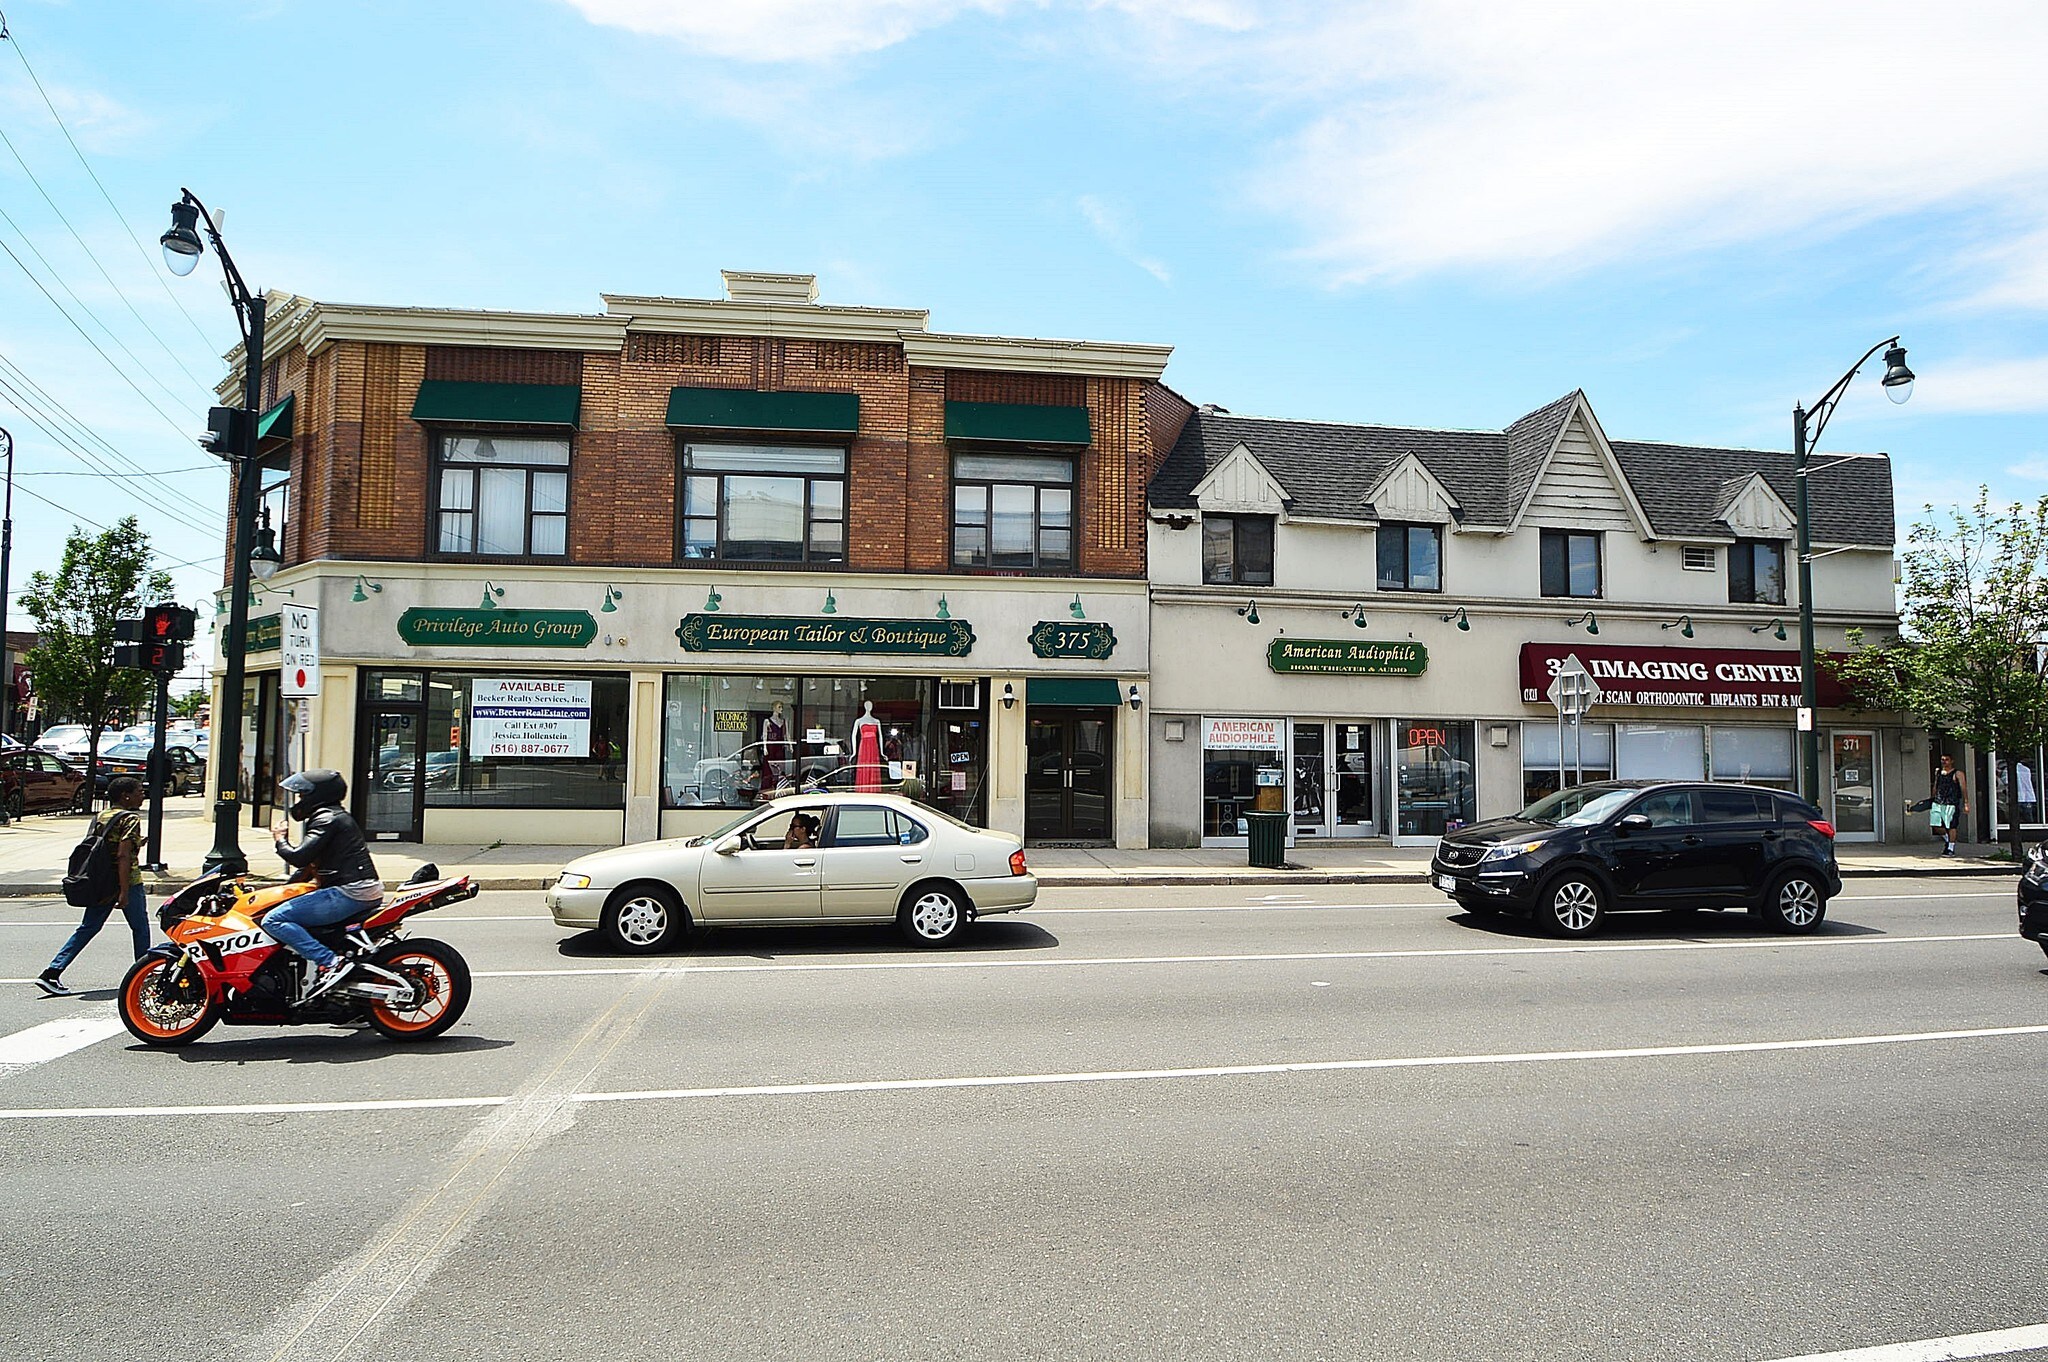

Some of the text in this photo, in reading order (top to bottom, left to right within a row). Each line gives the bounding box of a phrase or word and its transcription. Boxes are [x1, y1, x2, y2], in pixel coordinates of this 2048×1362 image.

[291, 612, 308, 630] NO
[413, 617, 582, 638] Privilege Auto Group
[289, 634, 310, 648] TURN
[707, 624, 947, 649] European Tailor & Boutique
[1055, 631, 1091, 649] 375
[151, 647, 164, 665] 2
[285, 653, 315, 666] ON RED
[1282, 644, 1416, 665] American Audiophile
[1545, 658, 1567, 677] 3
[1589, 659, 1709, 680] IMAGING
[499, 682, 566, 692] AVAILABLE
[477, 694, 505, 702] Becker
[507, 695, 532, 704] Realty
[571, 695, 587, 703] Inc.
[1605, 690, 1632, 704] SCAN
[1636, 691, 1705, 705] ORTHODONTIC
[1710, 692, 1757, 706] IMPLANTS
[1761, 694, 1780, 707] ENT
[1781, 695, 1789, 707] &
[475, 707, 587, 718] www.BeckerRealEstate.com
[715, 711, 742, 721] TAILORING
[539, 722, 558, 730] #307
[715, 721, 748, 731] ALTERATIONS
[1212, 721, 1274, 733] AMERICAN
[493, 731, 568, 740] Jessica Hollenstein
[1408, 728, 1446, 746] OPEN
[490, 743, 569, 754] (516) 887-0677
[1843, 739, 1860, 751] 371
[951, 752, 969, 763] OPEN
[221, 790, 236, 801] 130
[187, 931, 263, 958] RPSOL
